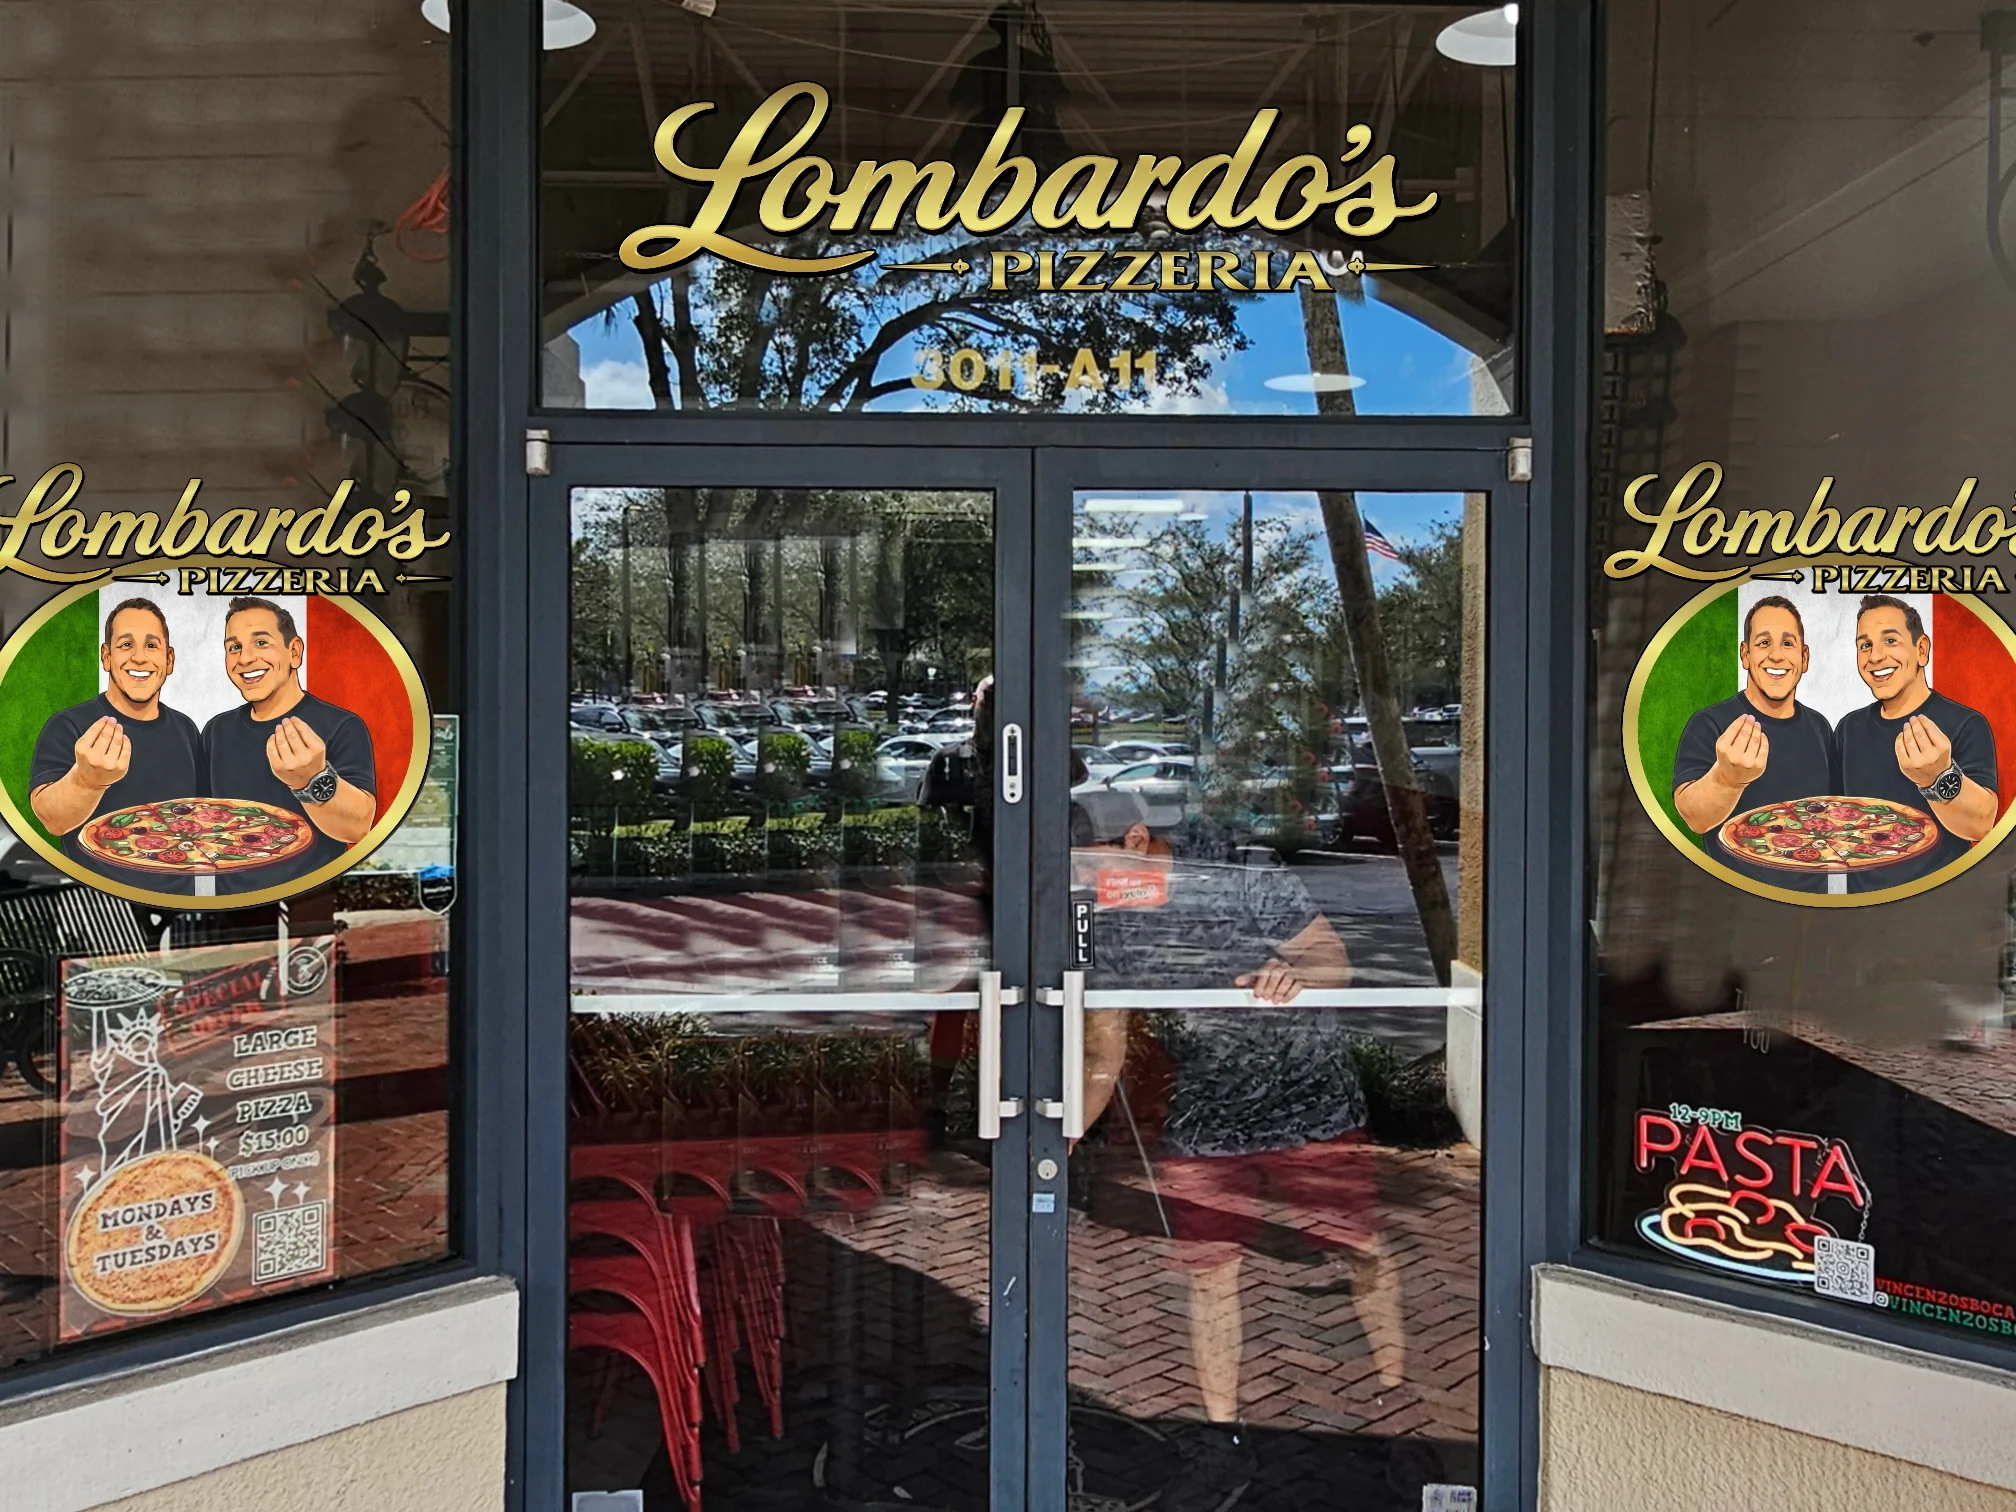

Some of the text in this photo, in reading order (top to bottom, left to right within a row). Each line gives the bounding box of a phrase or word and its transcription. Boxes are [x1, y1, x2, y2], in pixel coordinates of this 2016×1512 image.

[619, 81, 1438, 274] Lombardo's
[989, 250, 1335, 293] PIZZERIA
[911, 347, 1157, 390] 3011-A11
[1603, 460, 2016, 581] Lombardo
[179, 567, 388, 595] PIZZERIA
[1812, 565, 2010, 594] PIZZERIA
[1076, 904, 1089, 962] PULL
[234, 1027, 317, 1056] LARGE
[227, 1058, 323, 1090] CHEESE
[237, 1092, 311, 1122] PIZZA
[1669, 1102, 1742, 1131] 12-9PM
[1640, 1114, 1864, 1207] PASTA
[100, 1192, 213, 1230] MONDAYS
[145, 1224, 163, 1242] &
[96, 1233, 216, 1273] TUESDAYS
[1890, 1295, 2016, 1336] VINCENZOSB
